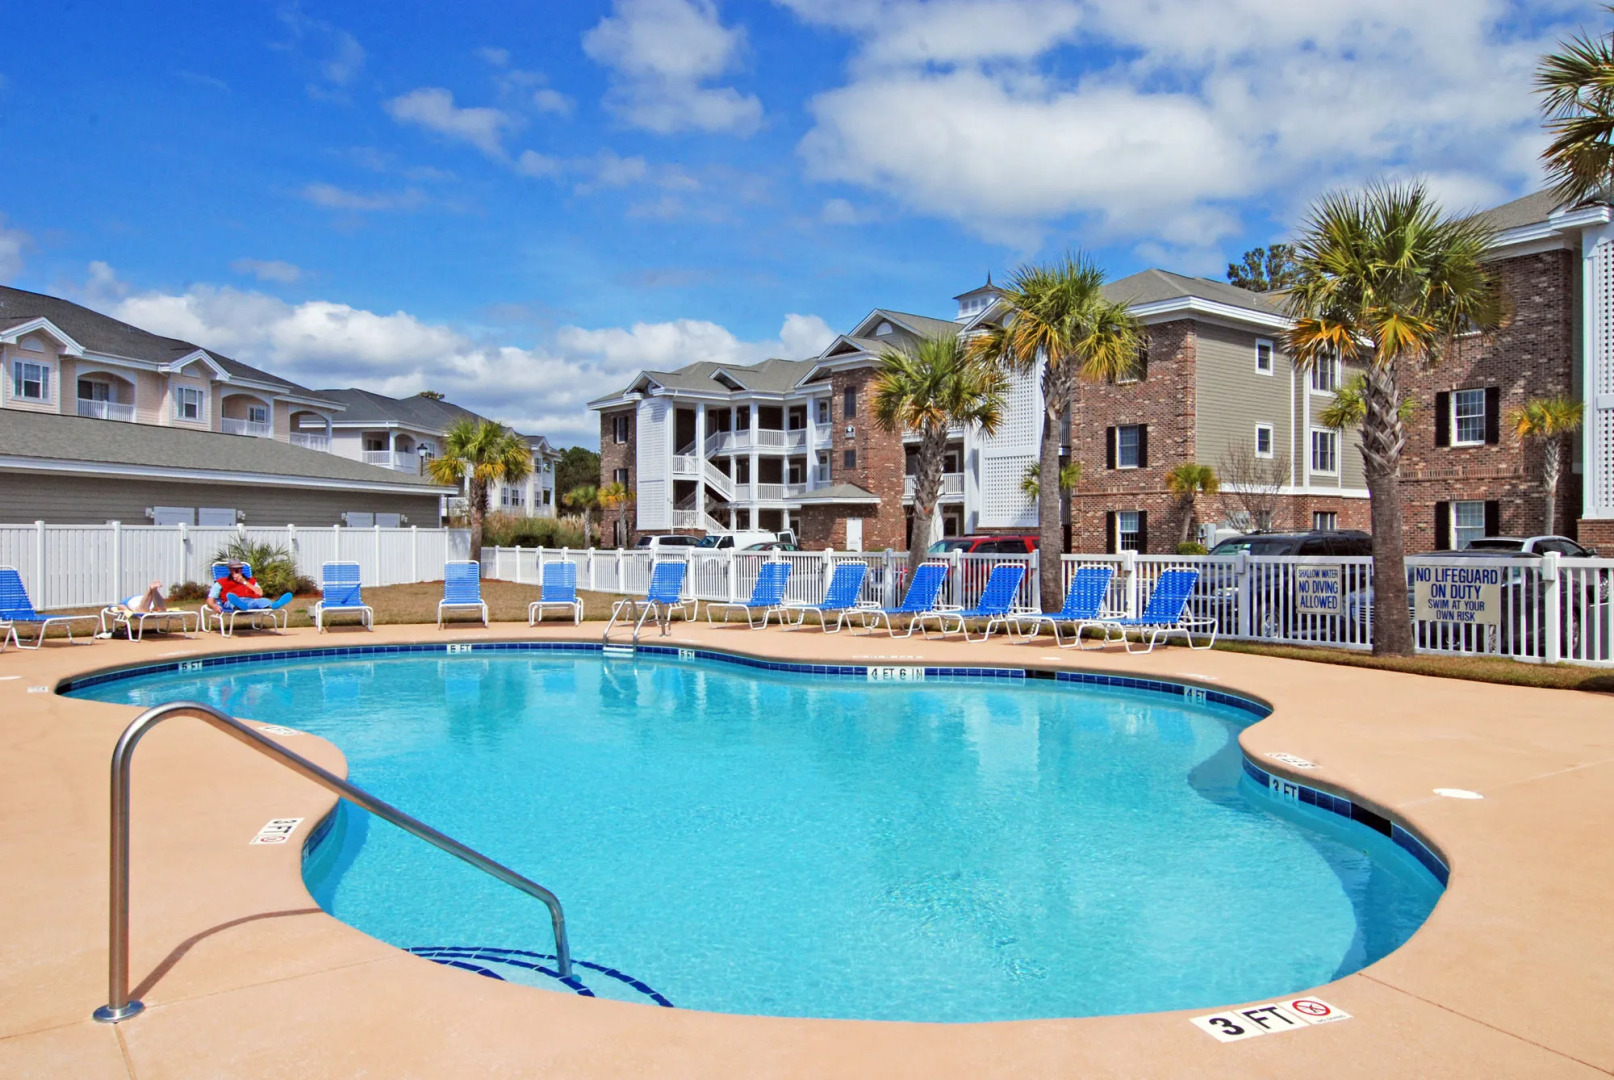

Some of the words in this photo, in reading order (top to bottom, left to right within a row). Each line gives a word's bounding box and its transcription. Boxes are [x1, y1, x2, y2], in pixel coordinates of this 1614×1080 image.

[1298, 569, 1320, 578] SHALLOW
[1321, 569, 1339, 578] WATER
[1416, 567, 1431, 582] NO
[1435, 567, 1498, 585] LIFEGUARD
[1299, 580, 1310, 594] NO
[1312, 580, 1339, 594] DIVING
[1431, 583, 1446, 598] ON
[1450, 584, 1481, 600] DUTY
[1300, 595, 1338, 609] ALLOWED
[1428, 599, 1450, 610] SWIM
[1452, 600, 1461, 610] AT
[1464, 600, 1485, 612] YOUR
[1436, 609, 1455, 620] OWN
[1457, 611, 1476, 622] RISK
[871, 668, 878, 679] 4
[899, 668, 907, 679] 6
[1208, 1017, 1245, 1036] 3
[1242, 1006, 1294, 1030] FT
